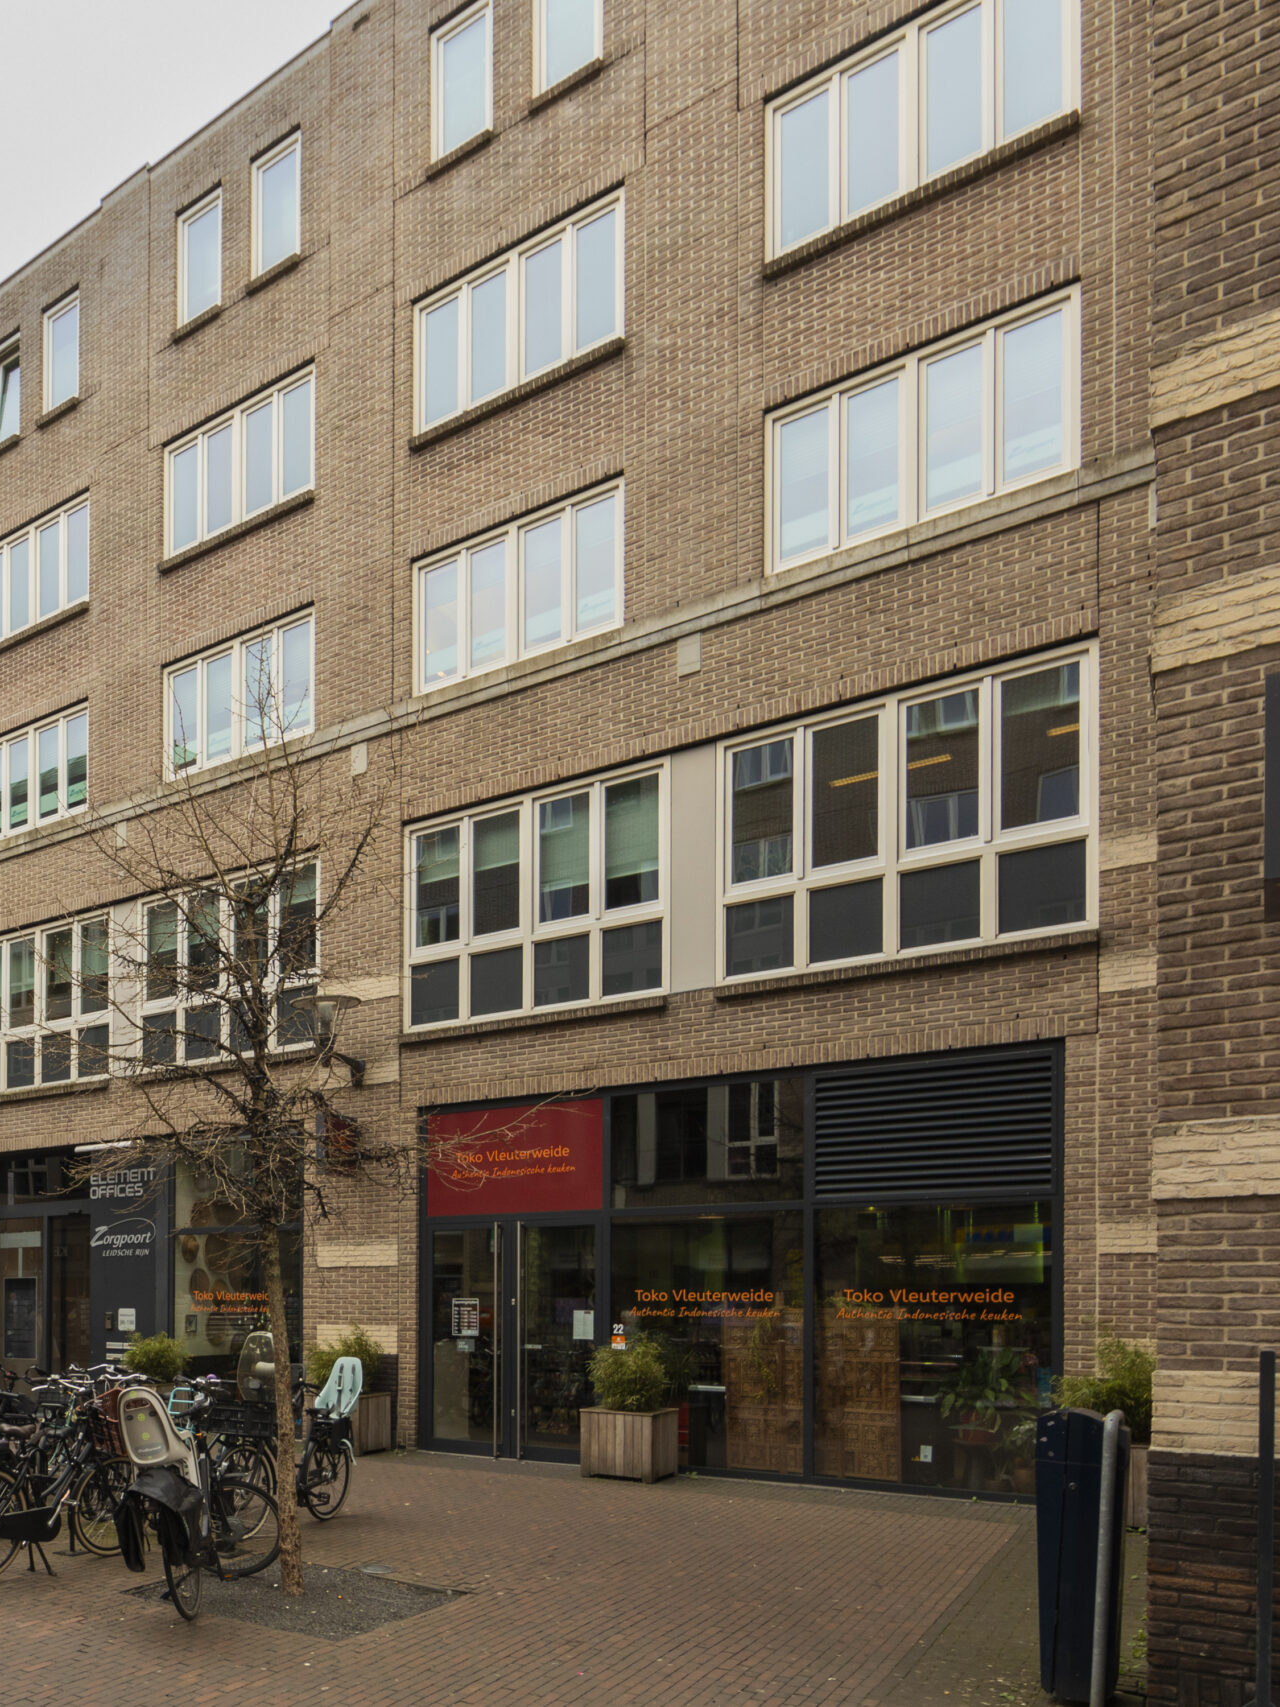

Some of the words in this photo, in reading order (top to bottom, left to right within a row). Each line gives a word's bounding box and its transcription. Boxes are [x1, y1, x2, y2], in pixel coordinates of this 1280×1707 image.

[456, 1152, 483, 1164] Toko
[487, 1145, 570, 1162] Vleuterweide
[90, 1167, 156, 1185] ELEMENT
[492, 1166, 545, 1177] Indonesische
[547, 1163, 576, 1173] keuken
[90, 1183, 143, 1199] OFFICES
[90, 1226, 152, 1248] Zorgpoort
[102, 1249, 132, 1257] LEIDSCHE
[135, 1248, 149, 1257] RIJN
[193, 1290, 214, 1301] Toko
[216, 1290, 269, 1301] Vleuterweid
[635, 1289, 668, 1302] Toko
[672, 1288, 774, 1302] Vleuterweide
[843, 1289, 884, 1303] Toko
[889, 1288, 1015, 1303] Vleuterweide
[629, 1306, 675, 1318] Authentic
[678, 1306, 742, 1318] Indonesische
[746, 1306, 780, 1318] keuken
[835, 1307, 893, 1321] Authentic
[895, 1308, 977, 1321] Indonesische
[979, 1309, 1024, 1321] keuken
[613, 1323, 624, 1334] 22
